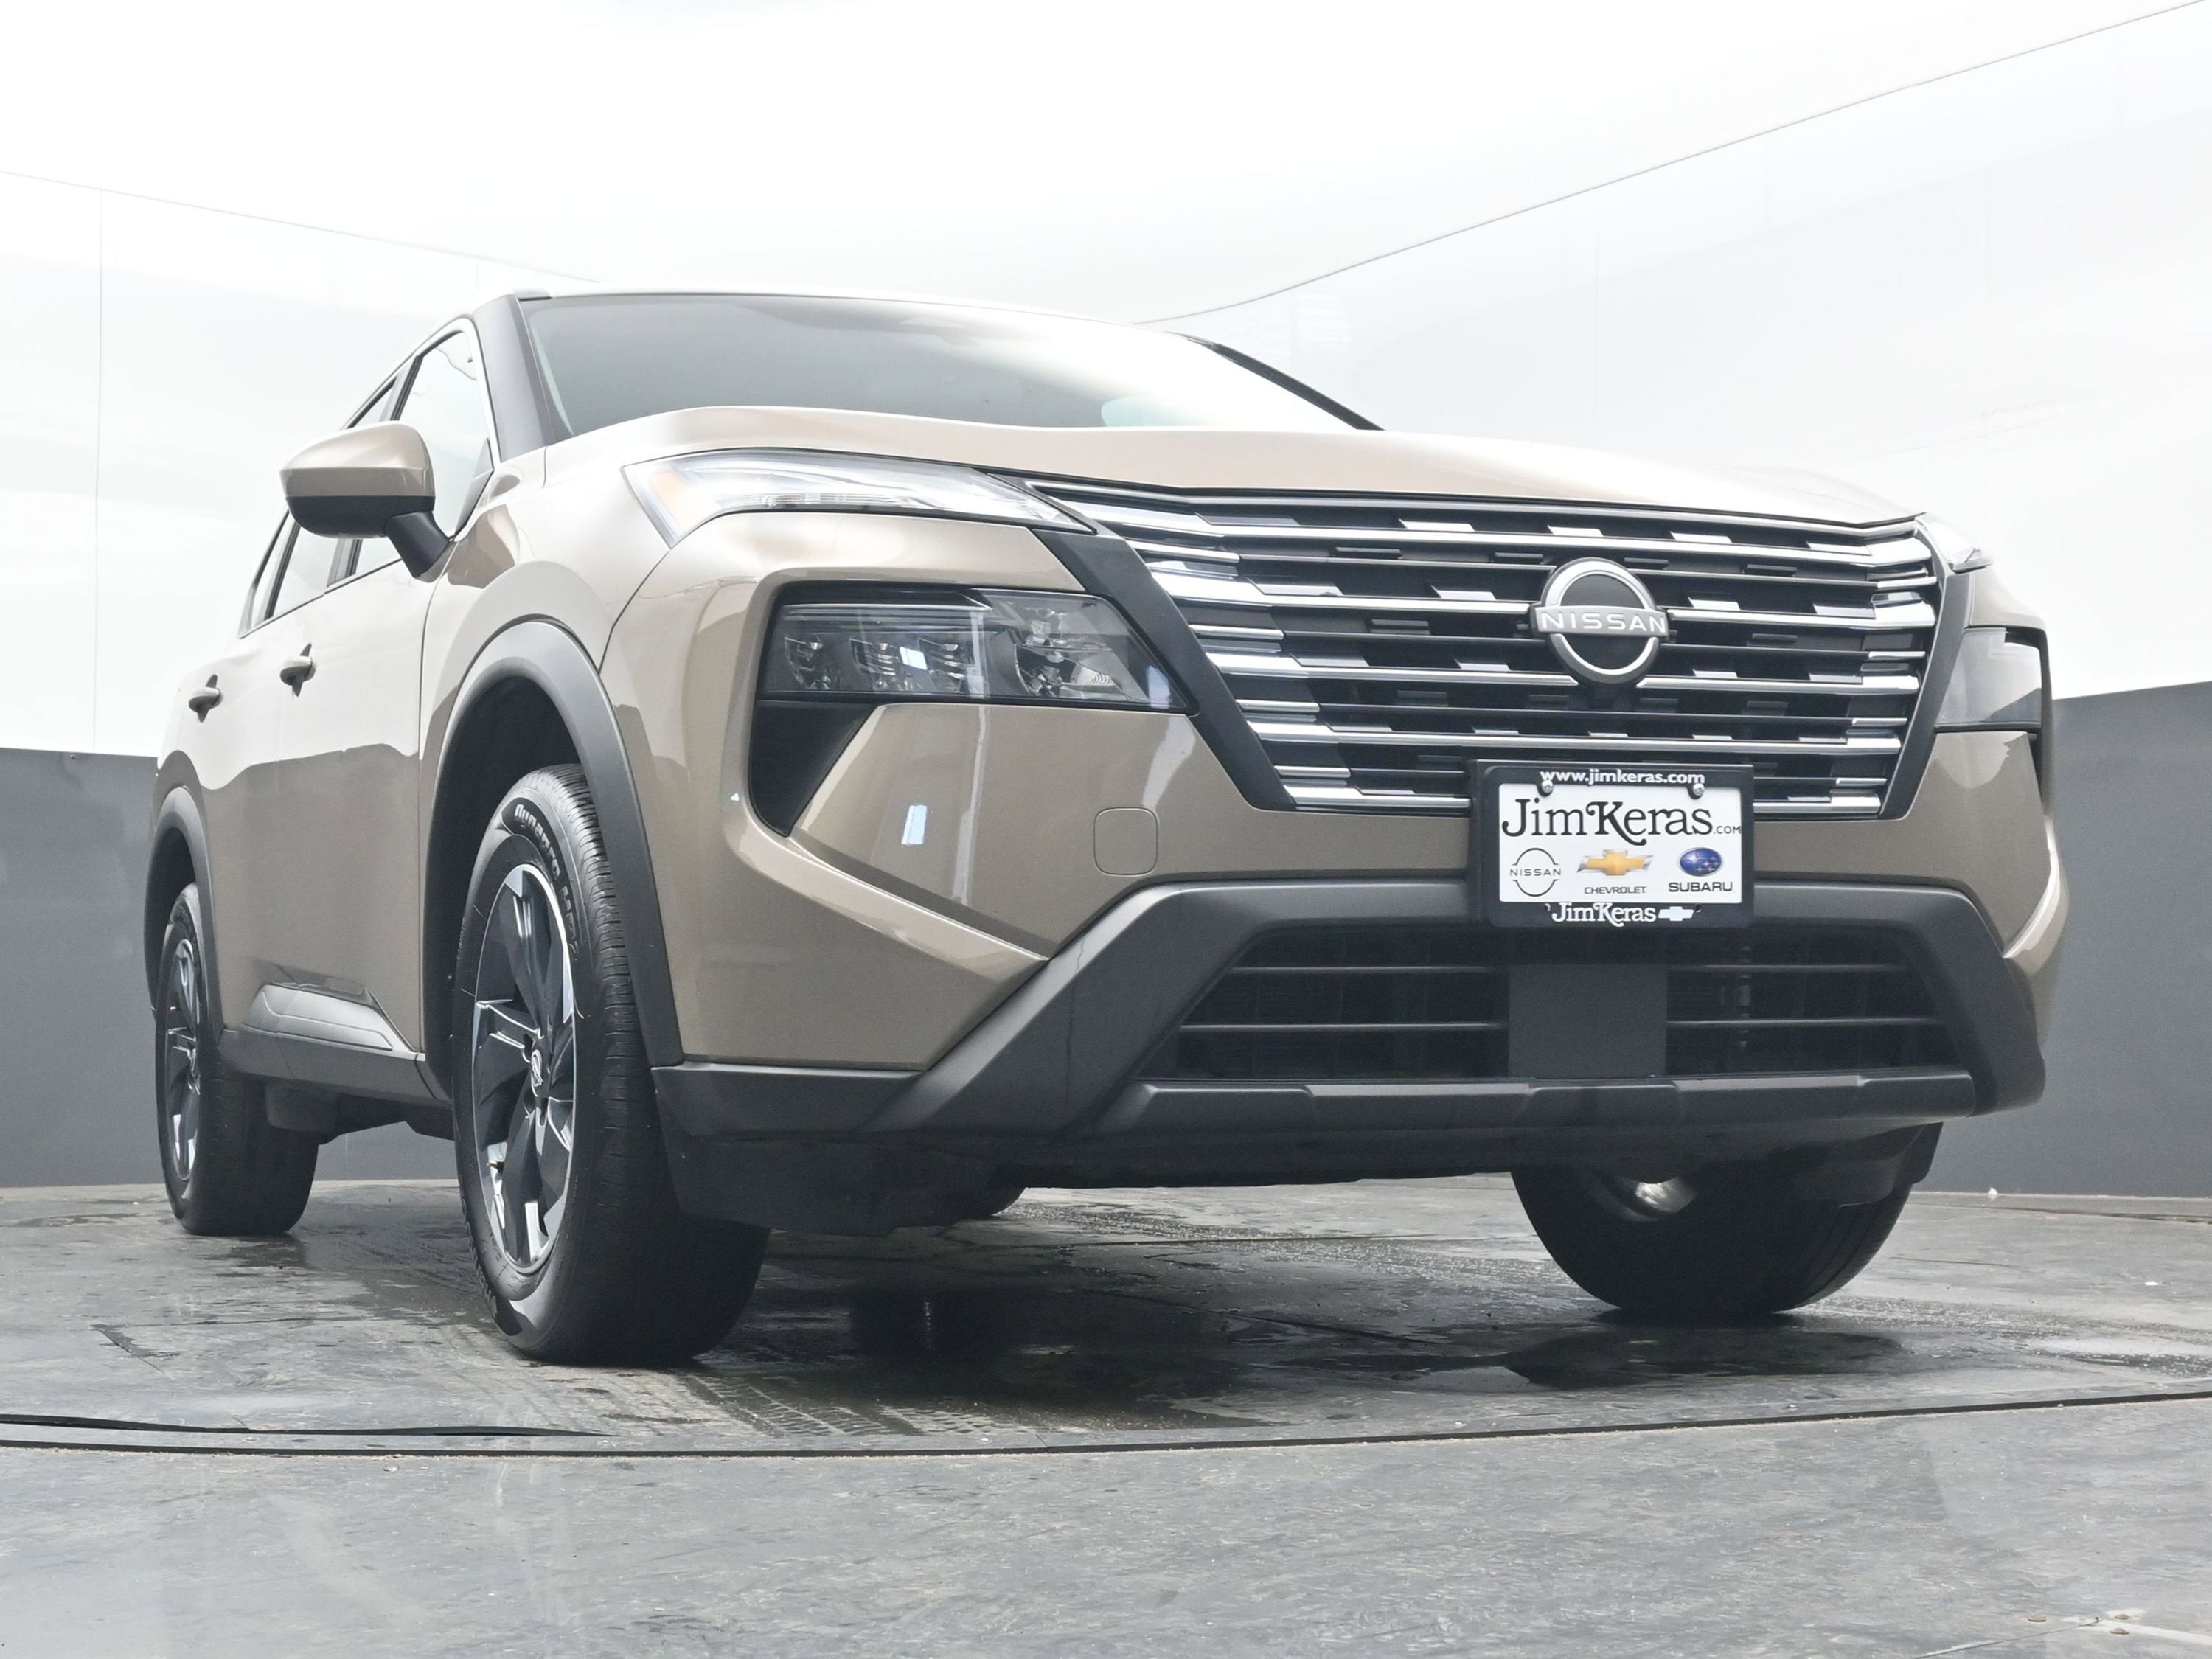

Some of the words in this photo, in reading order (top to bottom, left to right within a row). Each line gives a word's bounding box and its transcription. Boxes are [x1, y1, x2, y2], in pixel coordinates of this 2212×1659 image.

[1540, 611, 1666, 633] NISSAN
[1540, 768, 1705, 785] www.jimkeras.com
[514, 804, 560, 880] Dynapro
[1509, 867, 1562, 877] NISSAN
[1584, 886, 1647, 894] CHEVROLET
[1669, 882, 1733, 893] SUBARU
